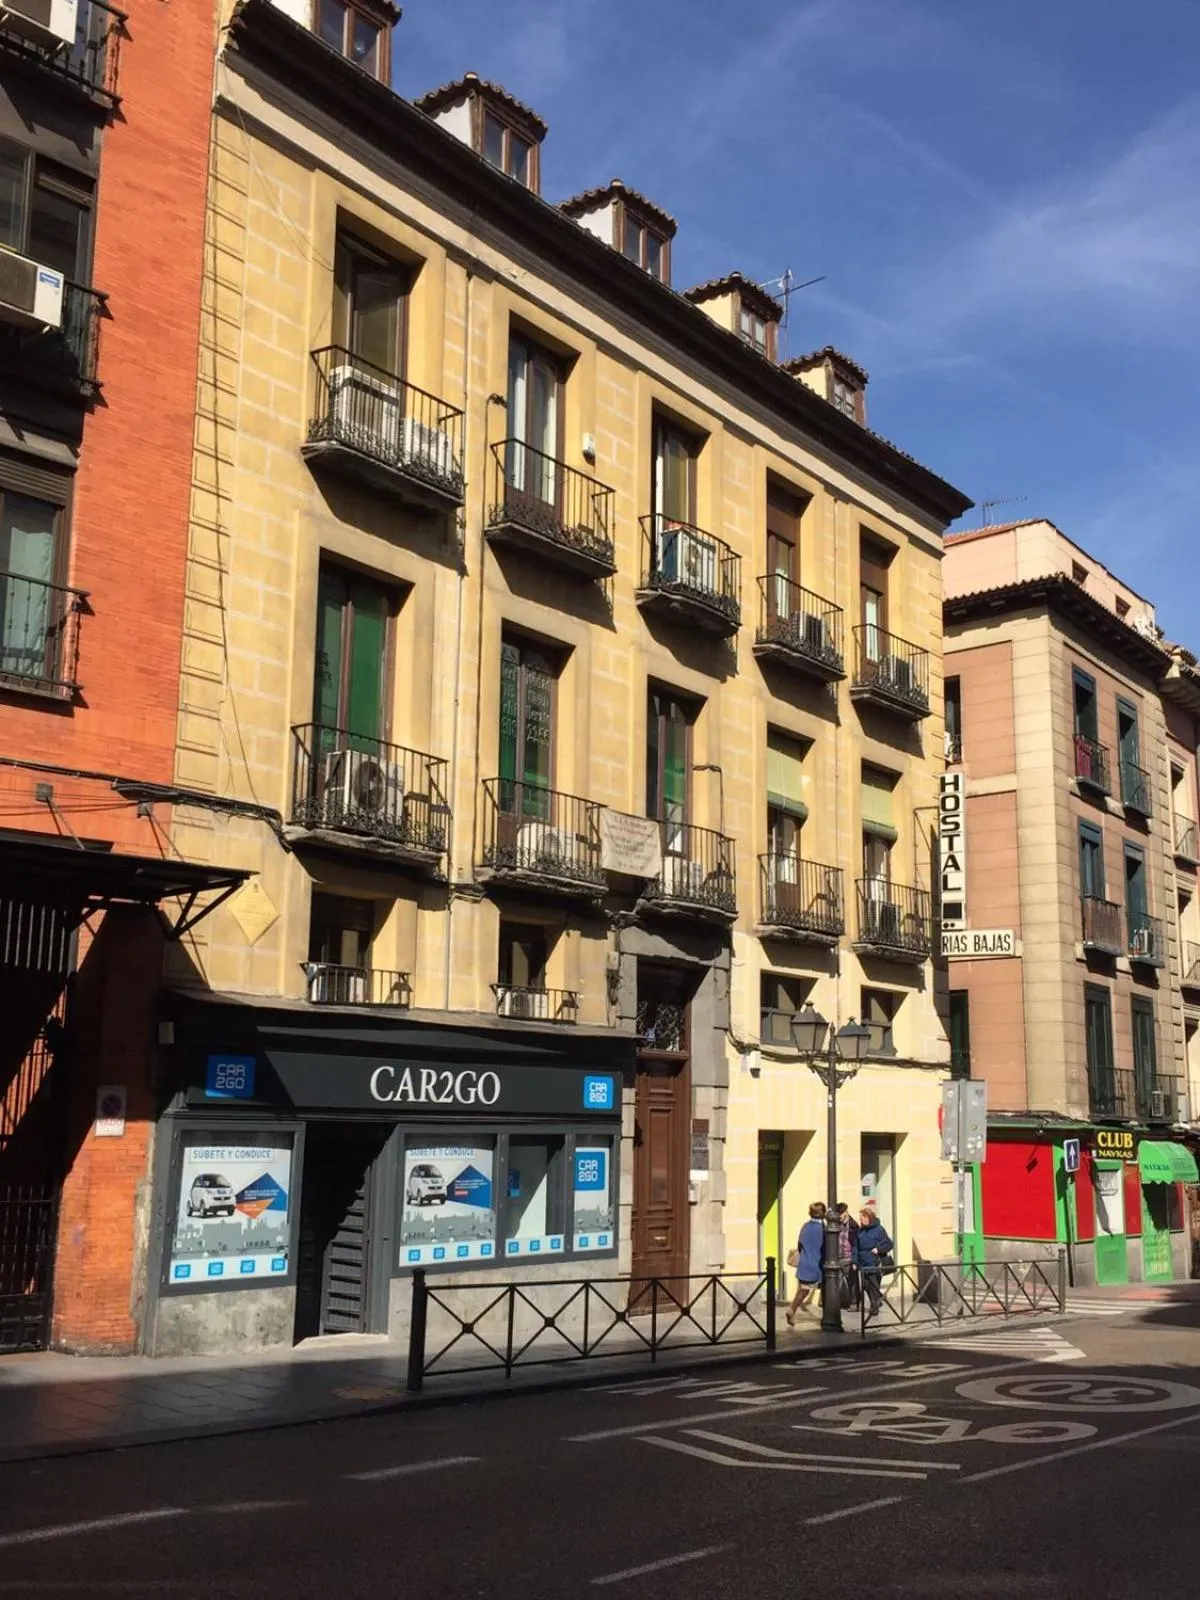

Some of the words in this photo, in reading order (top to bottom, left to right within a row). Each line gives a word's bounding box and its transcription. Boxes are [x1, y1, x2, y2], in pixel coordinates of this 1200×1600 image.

[940, 774, 961, 892] HOSTAL
[941, 934, 968, 953] RIAS
[973, 933, 1011, 953] BAJAS
[216, 1063, 246, 1077] CAR
[215, 1076, 245, 1090] 2GO
[369, 1066, 501, 1105] CAR2GO
[589, 1081, 607, 1092] CAR
[589, 1092, 607, 1103] 2GO
[1097, 1131, 1134, 1148] CLUB
[234, 1149, 271, 1159] CONDUCE
[578, 1159, 598, 1171] CAR
[578, 1171, 598, 1182] 2GO
[773, 1357, 971, 1377] BUS
[1008, 1380, 1155, 1404] 30
